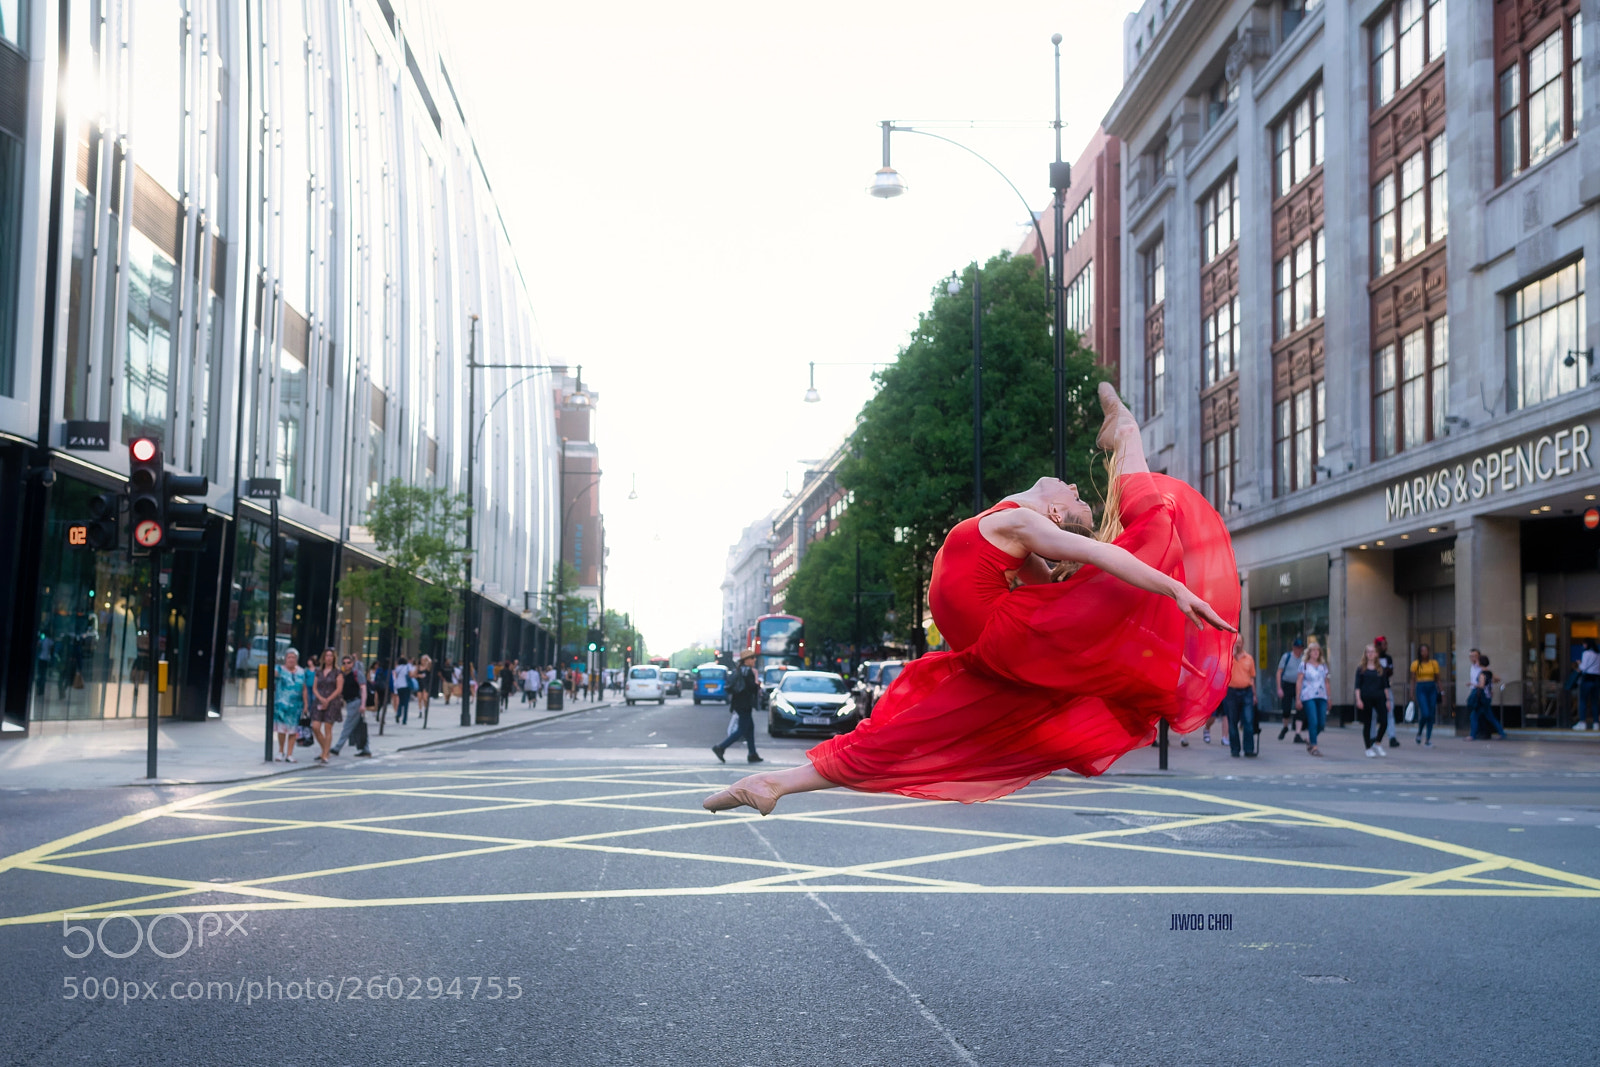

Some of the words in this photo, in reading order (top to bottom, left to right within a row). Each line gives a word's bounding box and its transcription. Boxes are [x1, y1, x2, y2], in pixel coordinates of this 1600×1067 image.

[70, 437, 105, 446] ZARA
[1385, 468, 1450, 522] MARKS
[1454, 464, 1469, 503] &
[1472, 424, 1592, 499] SPENCER
[70, 526, 87, 545] 02
